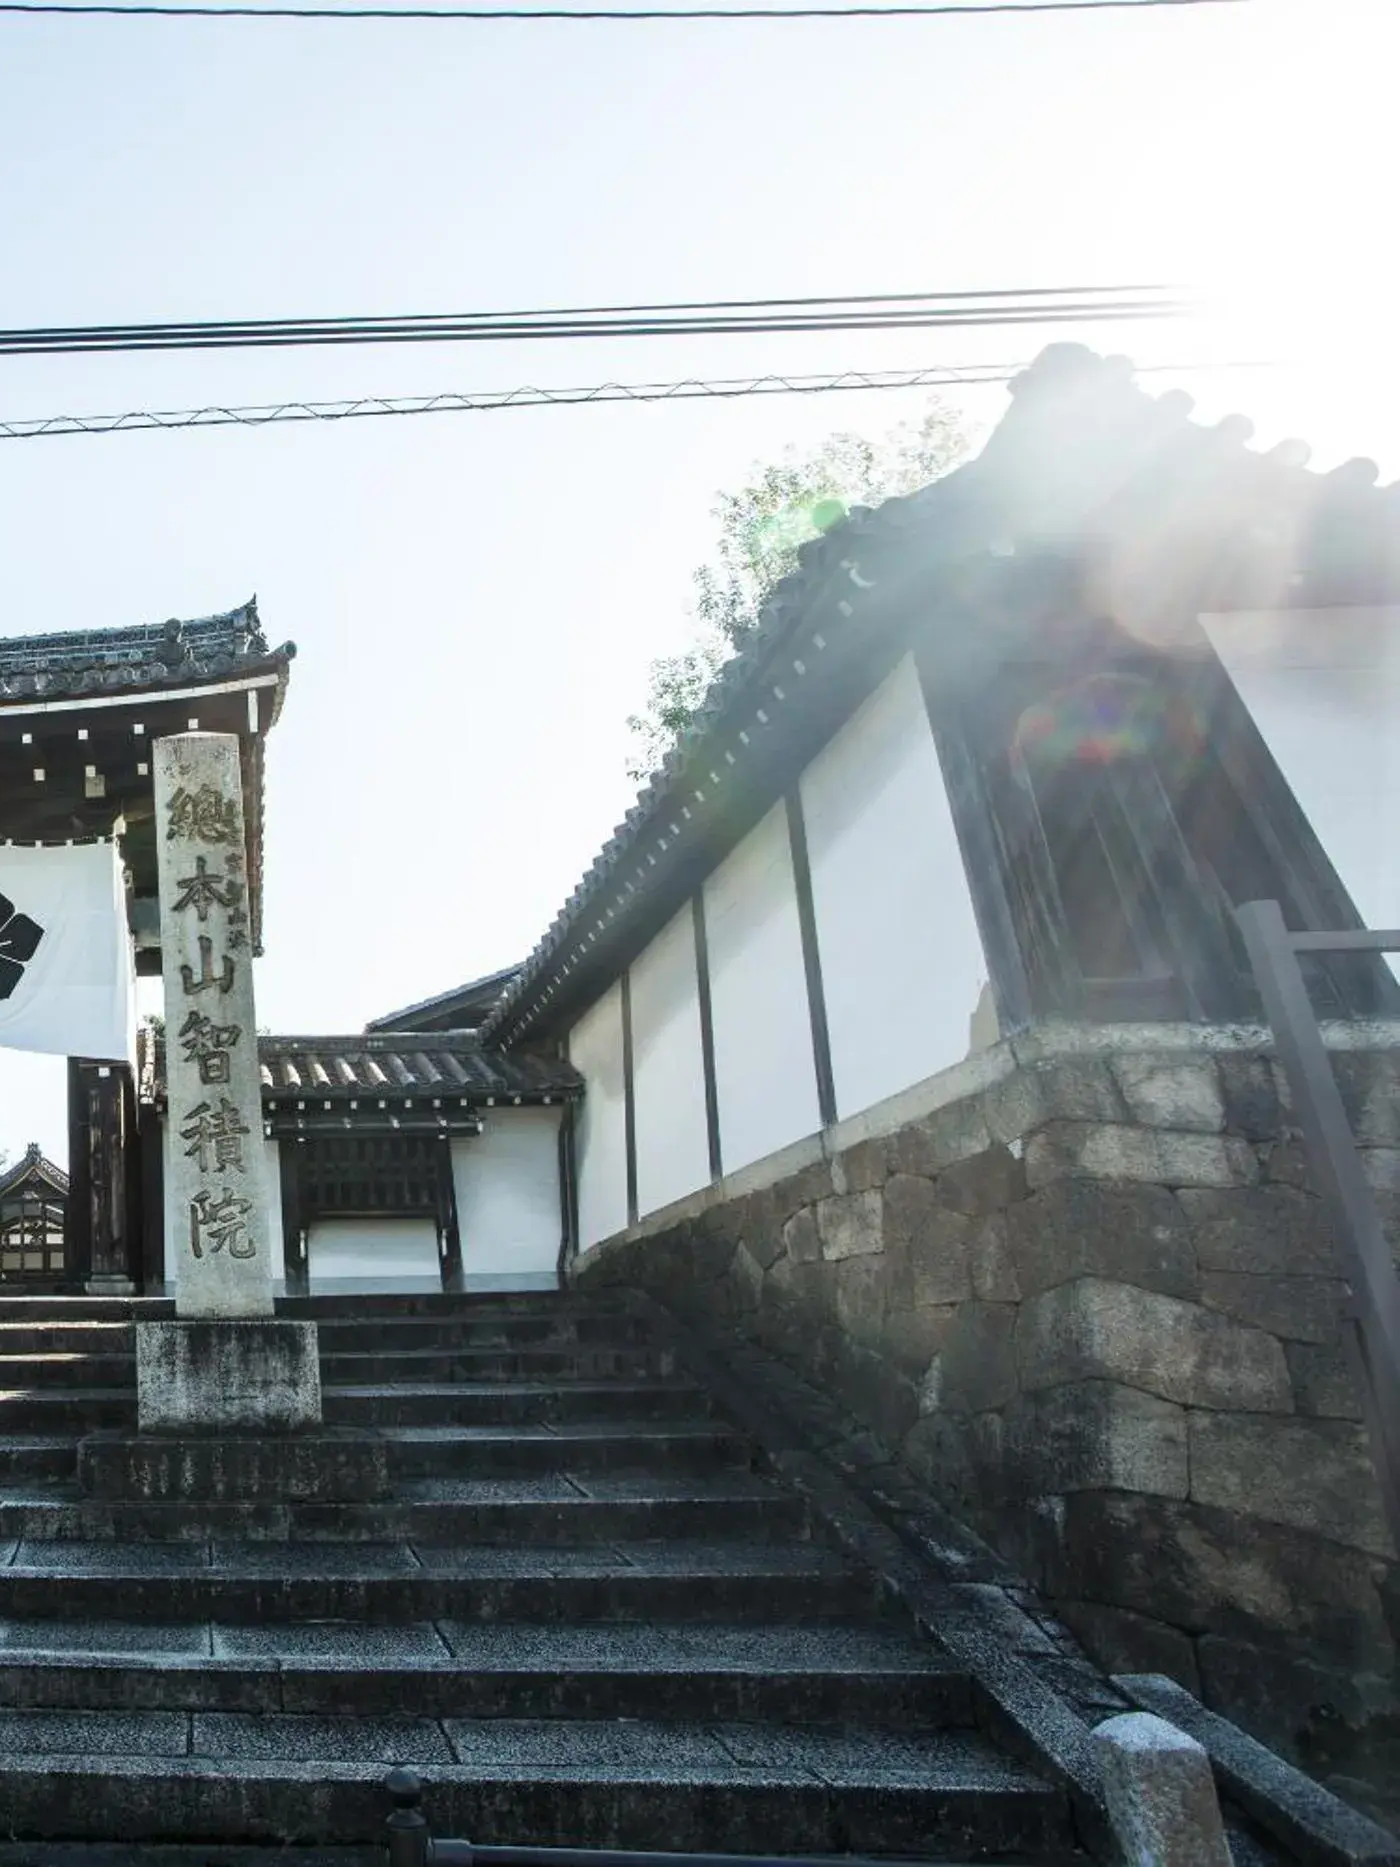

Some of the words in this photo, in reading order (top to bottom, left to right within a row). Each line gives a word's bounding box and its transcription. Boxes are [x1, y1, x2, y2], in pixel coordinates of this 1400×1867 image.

[165, 783, 257, 1261] 總本山智積院
